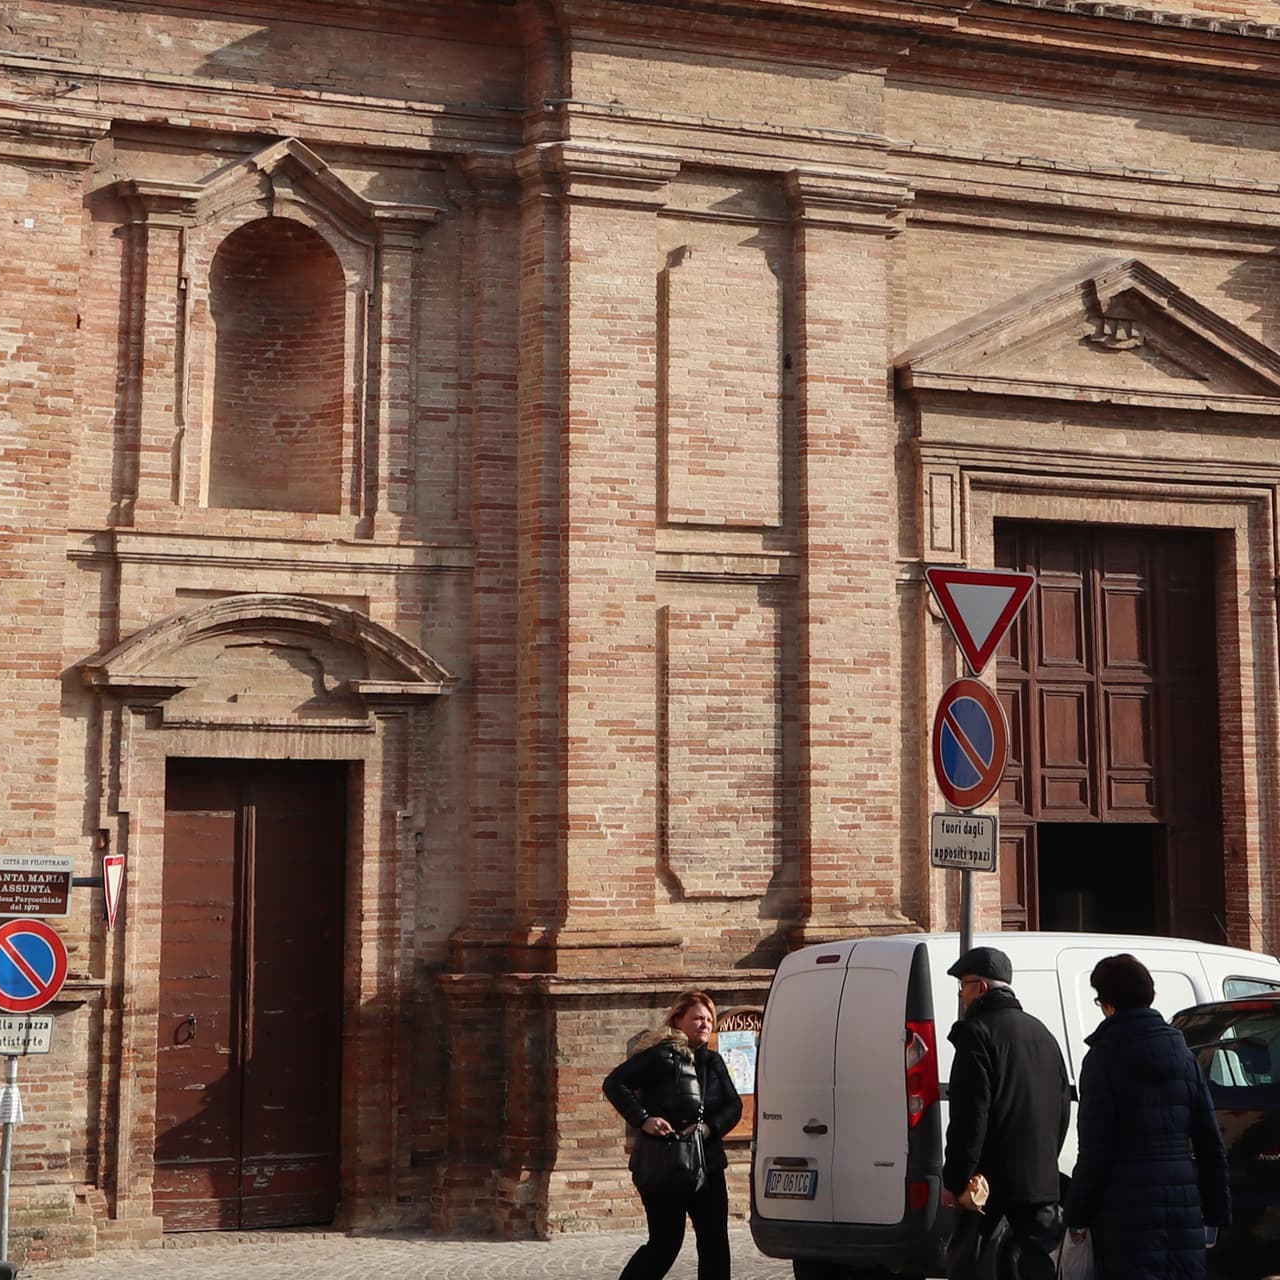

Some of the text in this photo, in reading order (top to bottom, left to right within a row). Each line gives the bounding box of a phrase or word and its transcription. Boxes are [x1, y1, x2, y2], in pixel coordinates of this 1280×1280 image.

[941, 820, 984, 839] fuori dagli
[934, 846, 967, 861] appositi
[969, 848, 990, 864] spazi
[27, 874, 64, 883] MARIA
[1, 884, 51, 893] ASSUNTA
[15, 895, 62, 904] Parrocchiale
[18, 1019, 49, 1033] piazza
